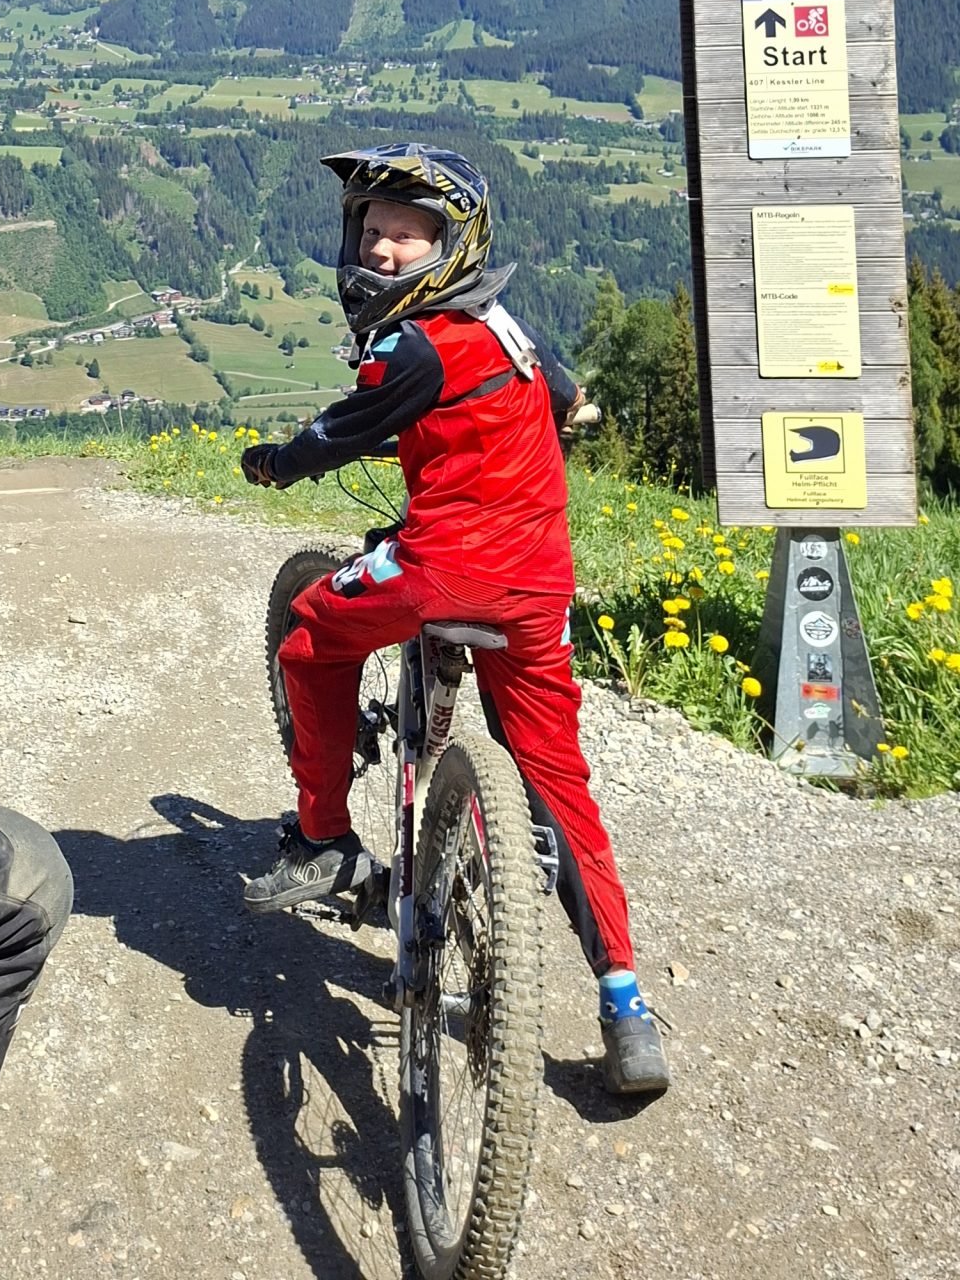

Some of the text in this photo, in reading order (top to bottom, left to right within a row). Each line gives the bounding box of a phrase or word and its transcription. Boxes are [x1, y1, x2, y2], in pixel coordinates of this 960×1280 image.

[763, 45, 827, 67] Start
[770, 78, 803, 86] Kessler
[806, 77, 825, 85] Line
[757, 212, 800, 220] MTB-Regeln
